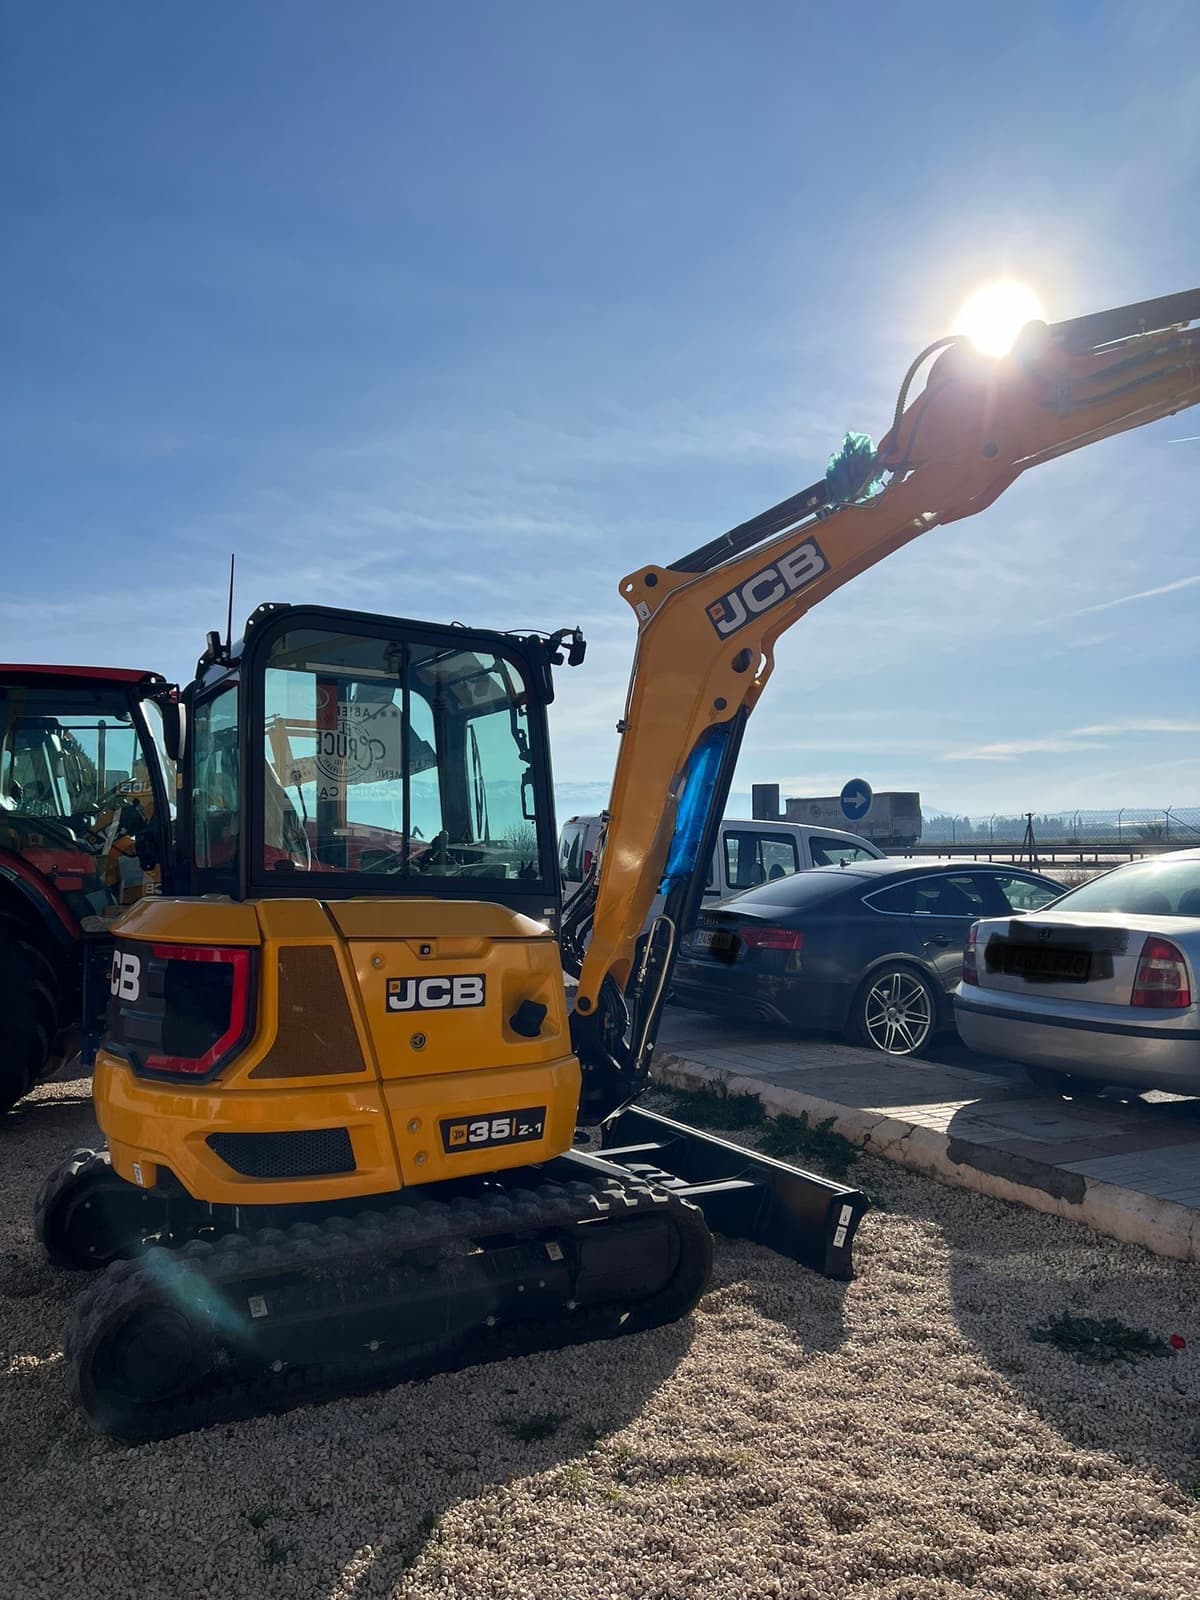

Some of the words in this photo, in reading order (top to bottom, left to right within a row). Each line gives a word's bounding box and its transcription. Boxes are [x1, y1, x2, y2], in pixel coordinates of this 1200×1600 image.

[716, 543, 825, 633] JCB
[389, 977, 483, 1009] JCB
[469, 1118, 511, 1143] 35
[518, 1122, 543, 1136] Z-1
